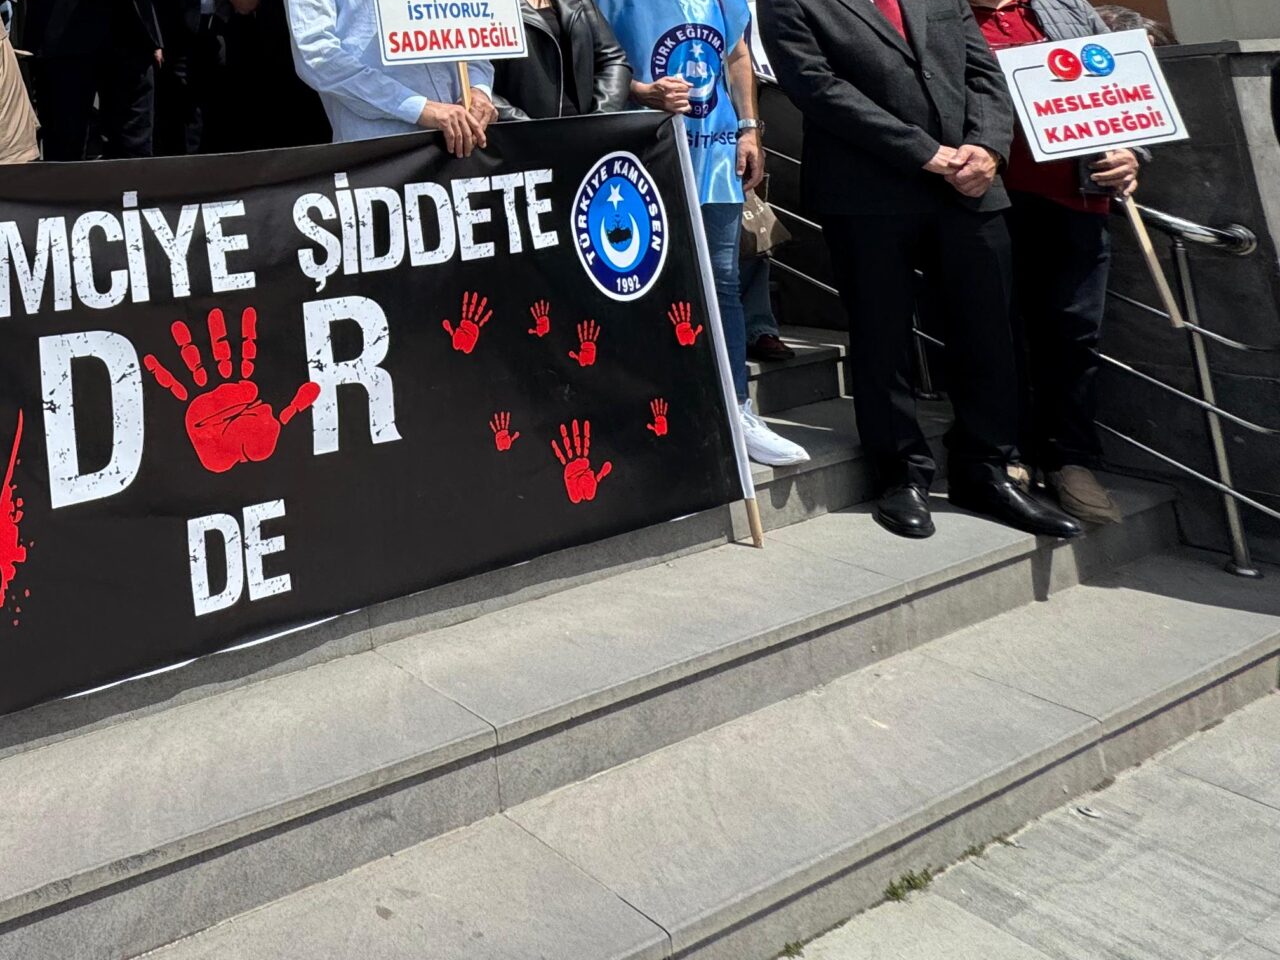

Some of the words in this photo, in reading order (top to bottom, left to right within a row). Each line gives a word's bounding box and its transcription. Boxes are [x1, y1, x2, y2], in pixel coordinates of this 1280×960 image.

[407, 0, 494, 20] İSTİYORUZ,
[388, 28, 467, 53] SADAKA
[468, 22, 518, 48] DEĞİL!
[654, 38, 676, 75] TÜRK
[1033, 83, 1155, 117] MESLEĞİME
[1043, 120, 1093, 144] KAN
[1095, 106, 1166, 135] DEĞDİ!
[292, 168, 560, 292] ŞİDDETE
[578, 165, 608, 266] TÜRKİYE
[613, 160, 662, 251] KAMU-SEN
[616, 274, 641, 293] 1992
[186, 497, 292, 618] DE
